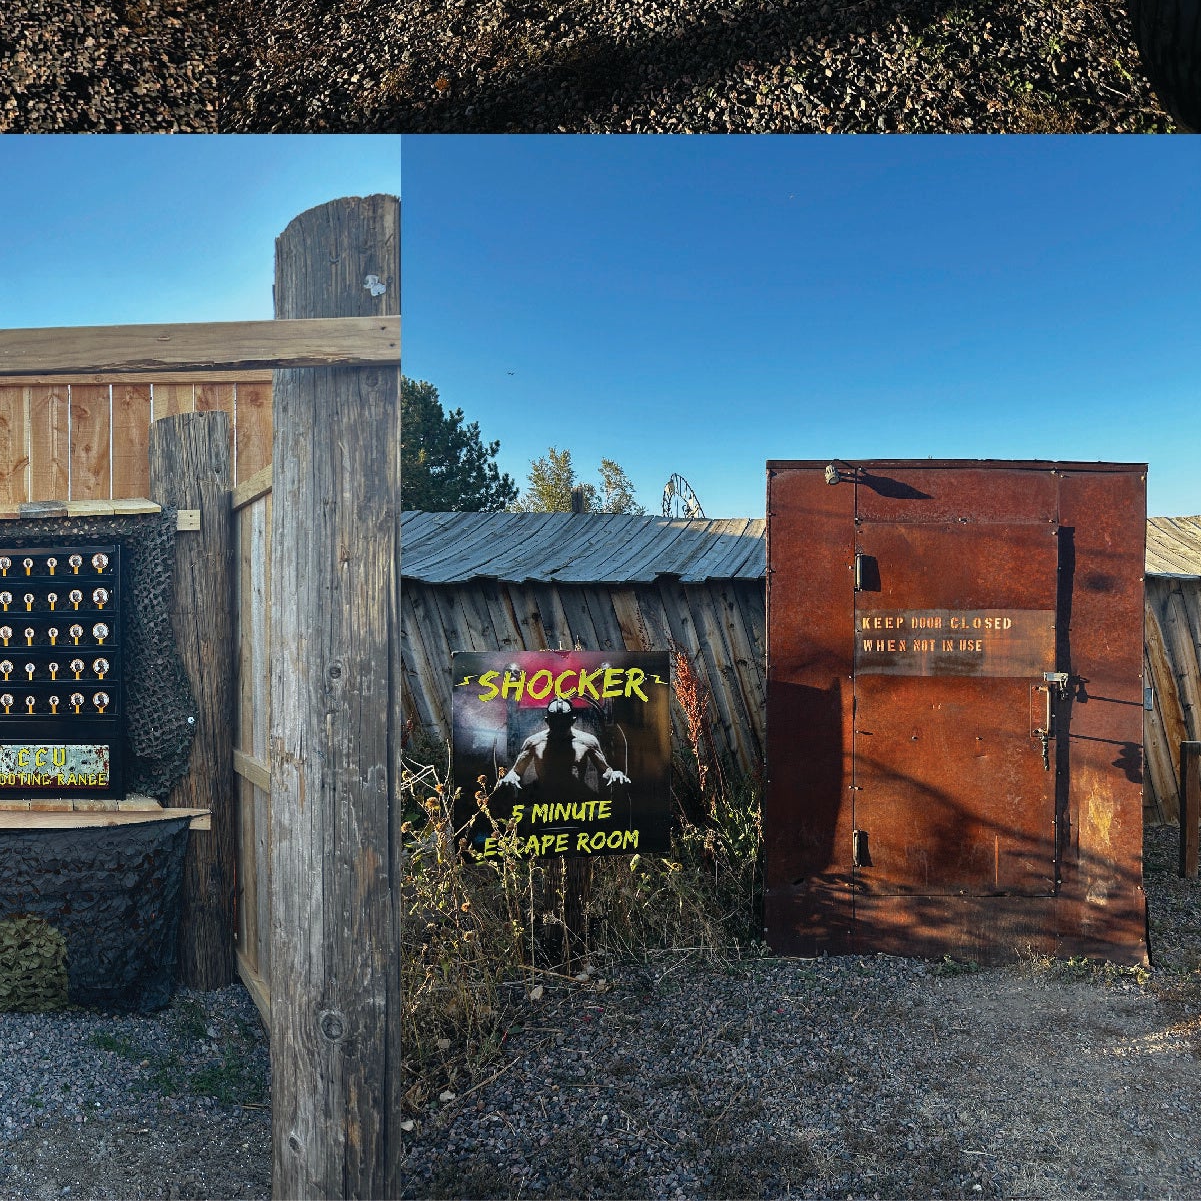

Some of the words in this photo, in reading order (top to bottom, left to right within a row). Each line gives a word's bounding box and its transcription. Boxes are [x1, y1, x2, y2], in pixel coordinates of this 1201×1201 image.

[862, 617, 904, 630] KEEP
[911, 617, 942, 630] DOOR
[950, 617, 1013, 630] CLOSED
[863, 639, 907, 652] WHEN
[913, 639, 936, 652] NOT
[942, 639, 954, 652] IN
[959, 639, 983, 652] USE
[478, 667, 649, 702] SHOCKER
[18, 747, 67, 767] CCU
[57, 772, 108, 786] RANGE
[511, 804, 525, 824] 5
[531, 800, 612, 824] MINUTE
[576, 829, 640, 854] ROOM
